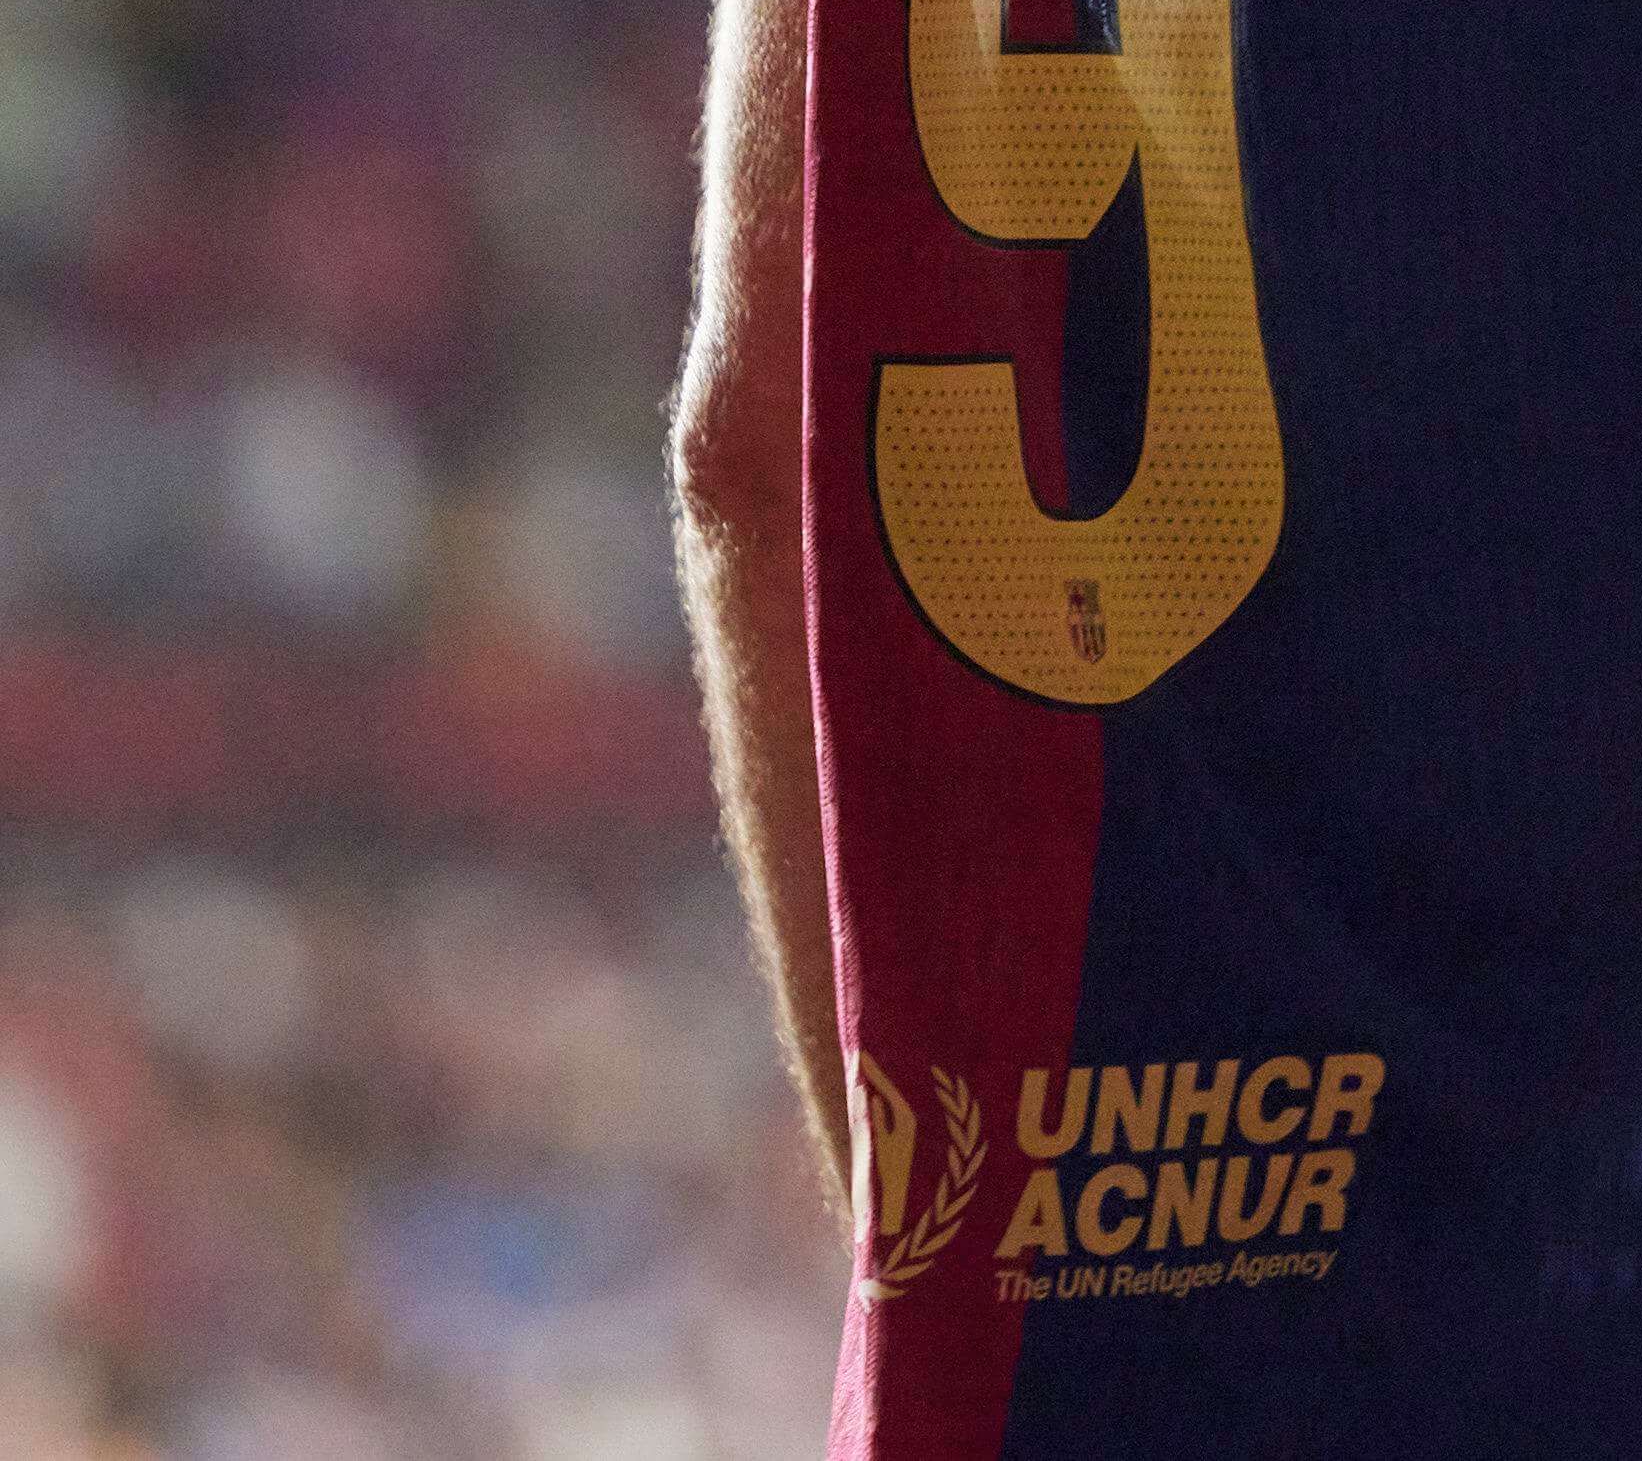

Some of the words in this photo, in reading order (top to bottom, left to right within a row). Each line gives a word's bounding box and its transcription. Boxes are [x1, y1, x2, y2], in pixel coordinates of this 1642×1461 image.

[1013, 1051, 1387, 1160] UNHCR
[993, 1148, 1357, 1259] ACNUR
[994, 1269, 1050, 1302] The
[1056, 1266, 1106, 1299] UN
[1110, 1260, 1225, 1299] Refugee
[1226, 1250, 1340, 1287] Agency
